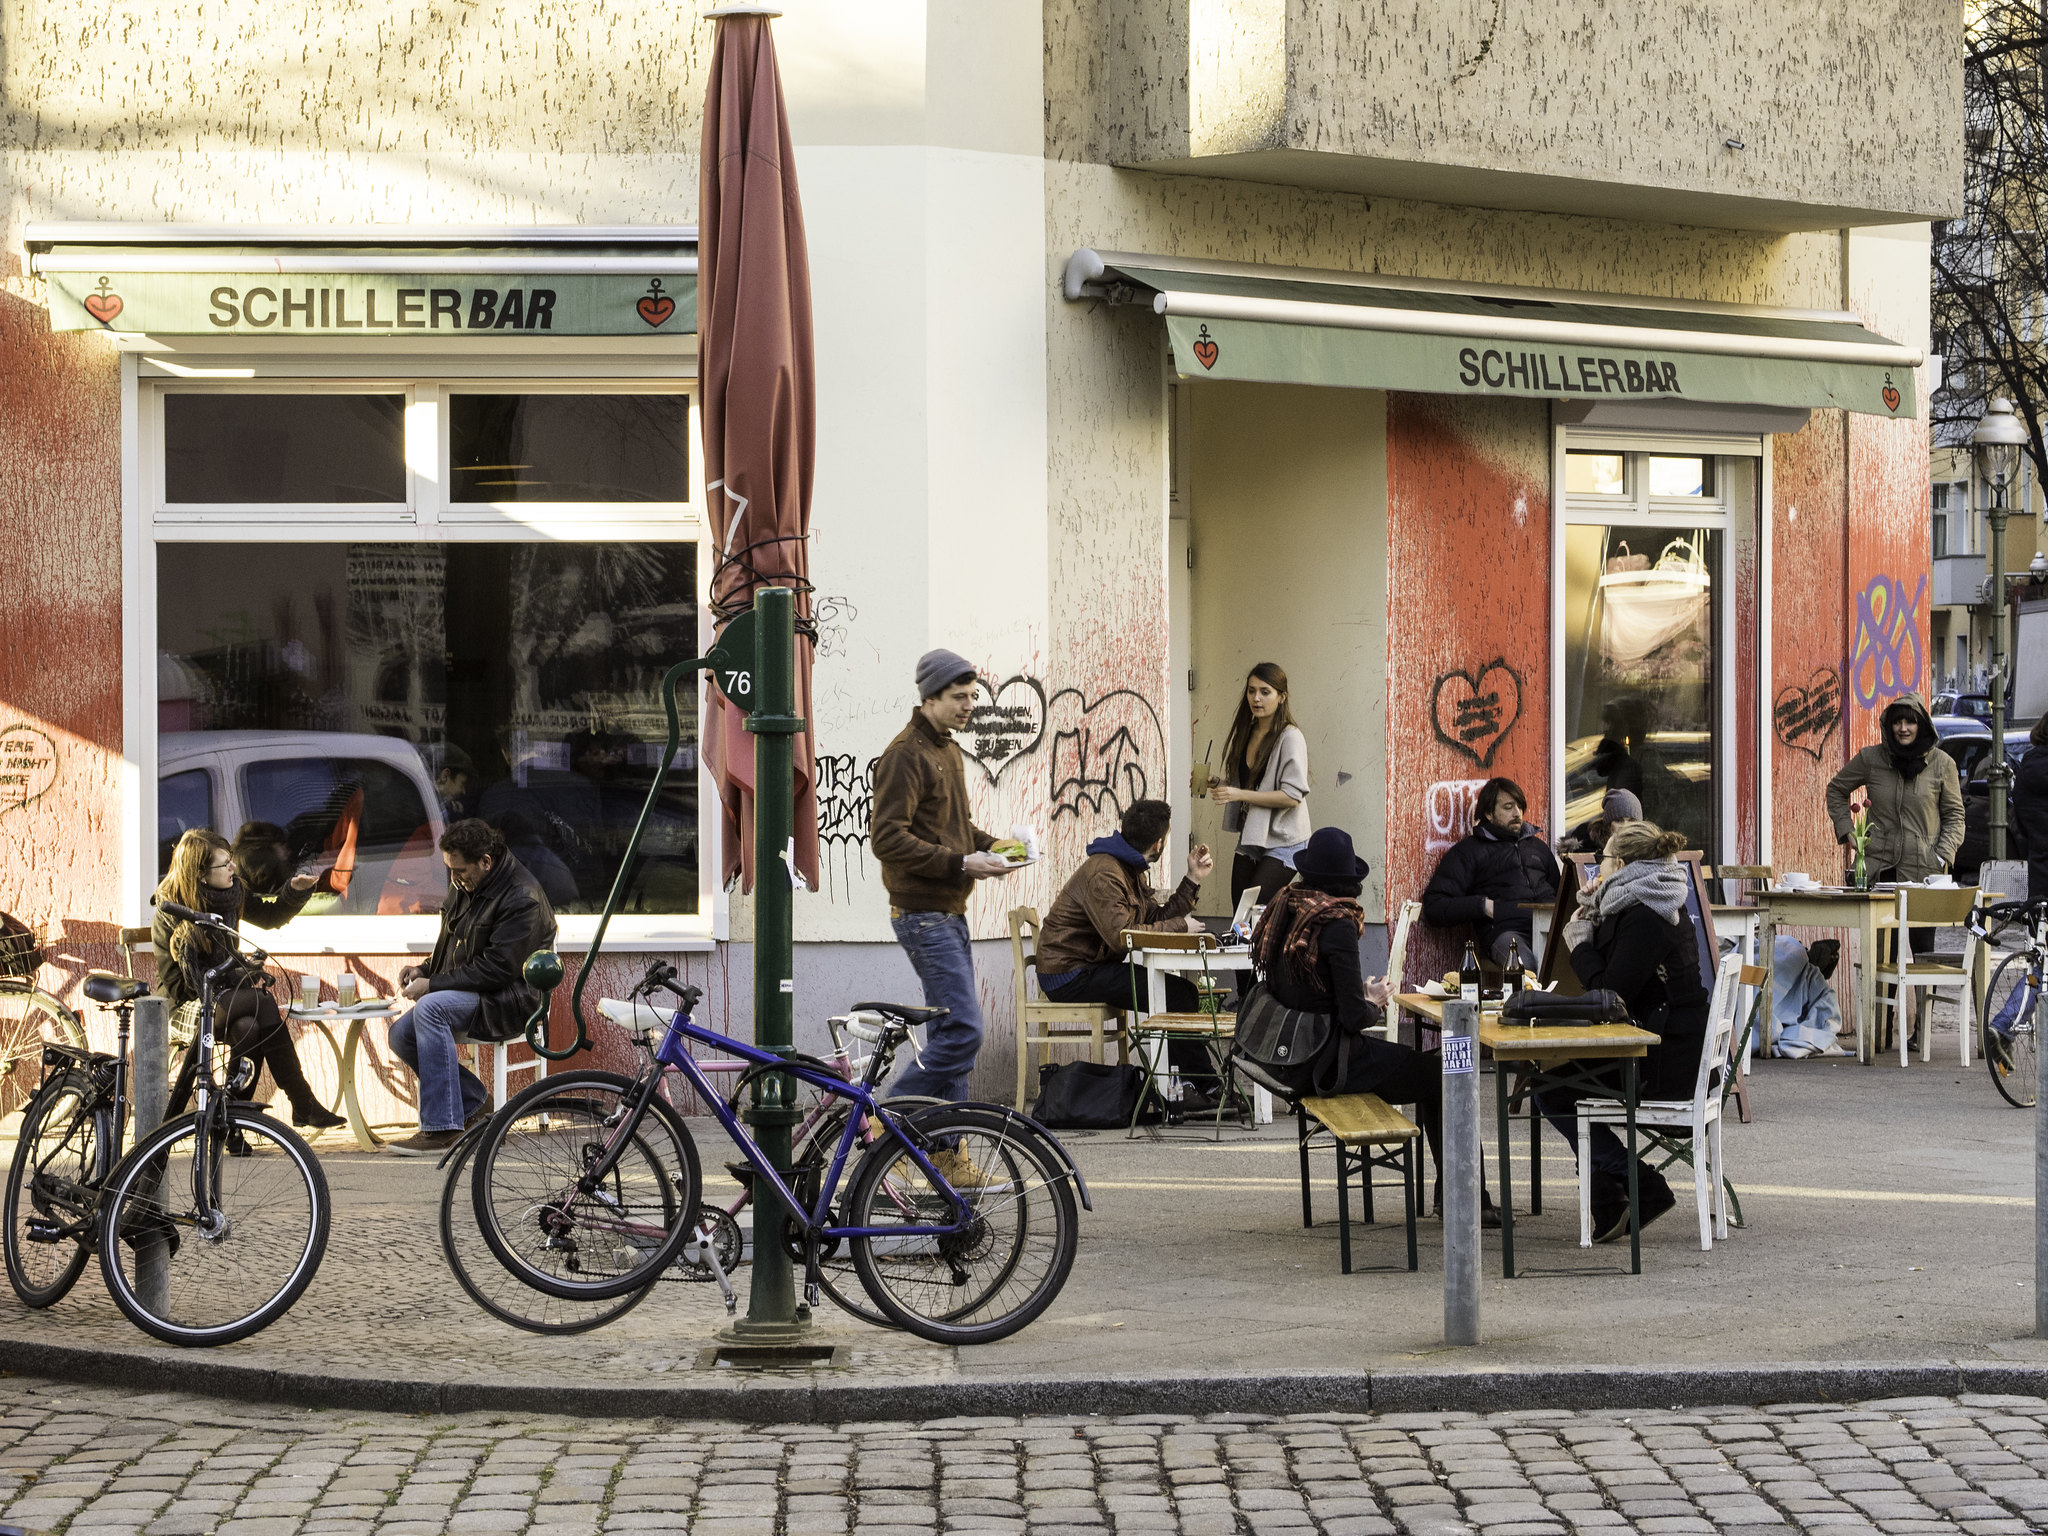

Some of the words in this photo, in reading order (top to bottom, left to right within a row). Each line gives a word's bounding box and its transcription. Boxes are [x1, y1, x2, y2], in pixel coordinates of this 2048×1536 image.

[208, 286, 557, 329] SCHILLERBAR
[1459, 348, 1682, 394] SCHILLERBAR
[725, 670, 751, 695] 76
